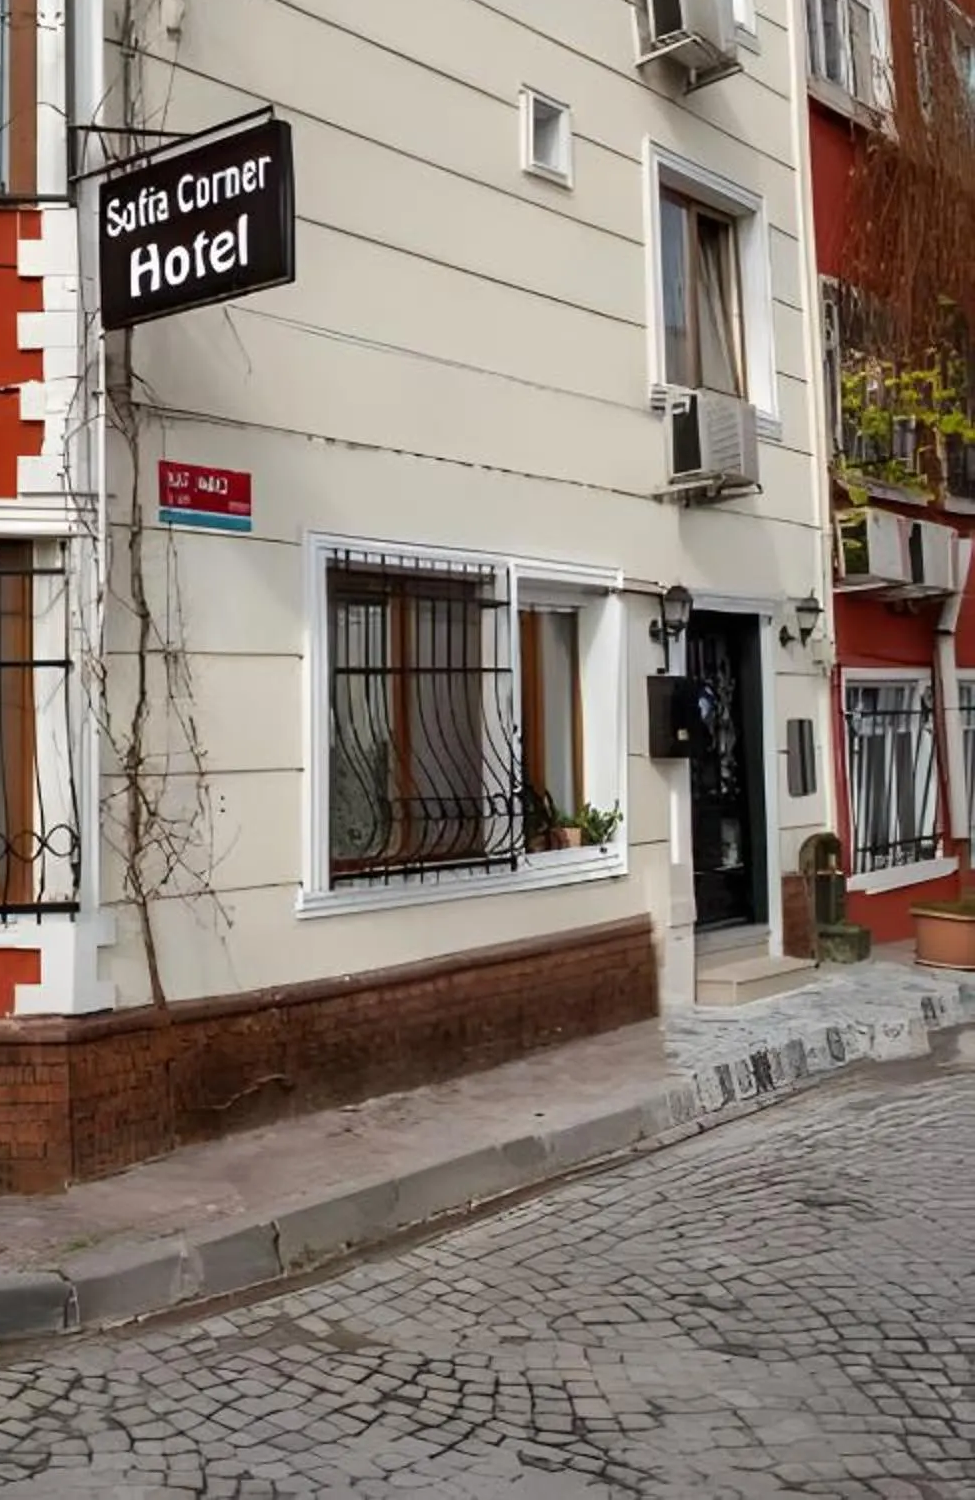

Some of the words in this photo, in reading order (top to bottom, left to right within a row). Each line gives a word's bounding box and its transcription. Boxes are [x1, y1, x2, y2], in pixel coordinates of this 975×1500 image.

[106, 186, 169, 237] Sofia
[177, 155, 272, 213] Corner
[130, 213, 248, 298] Hotel
